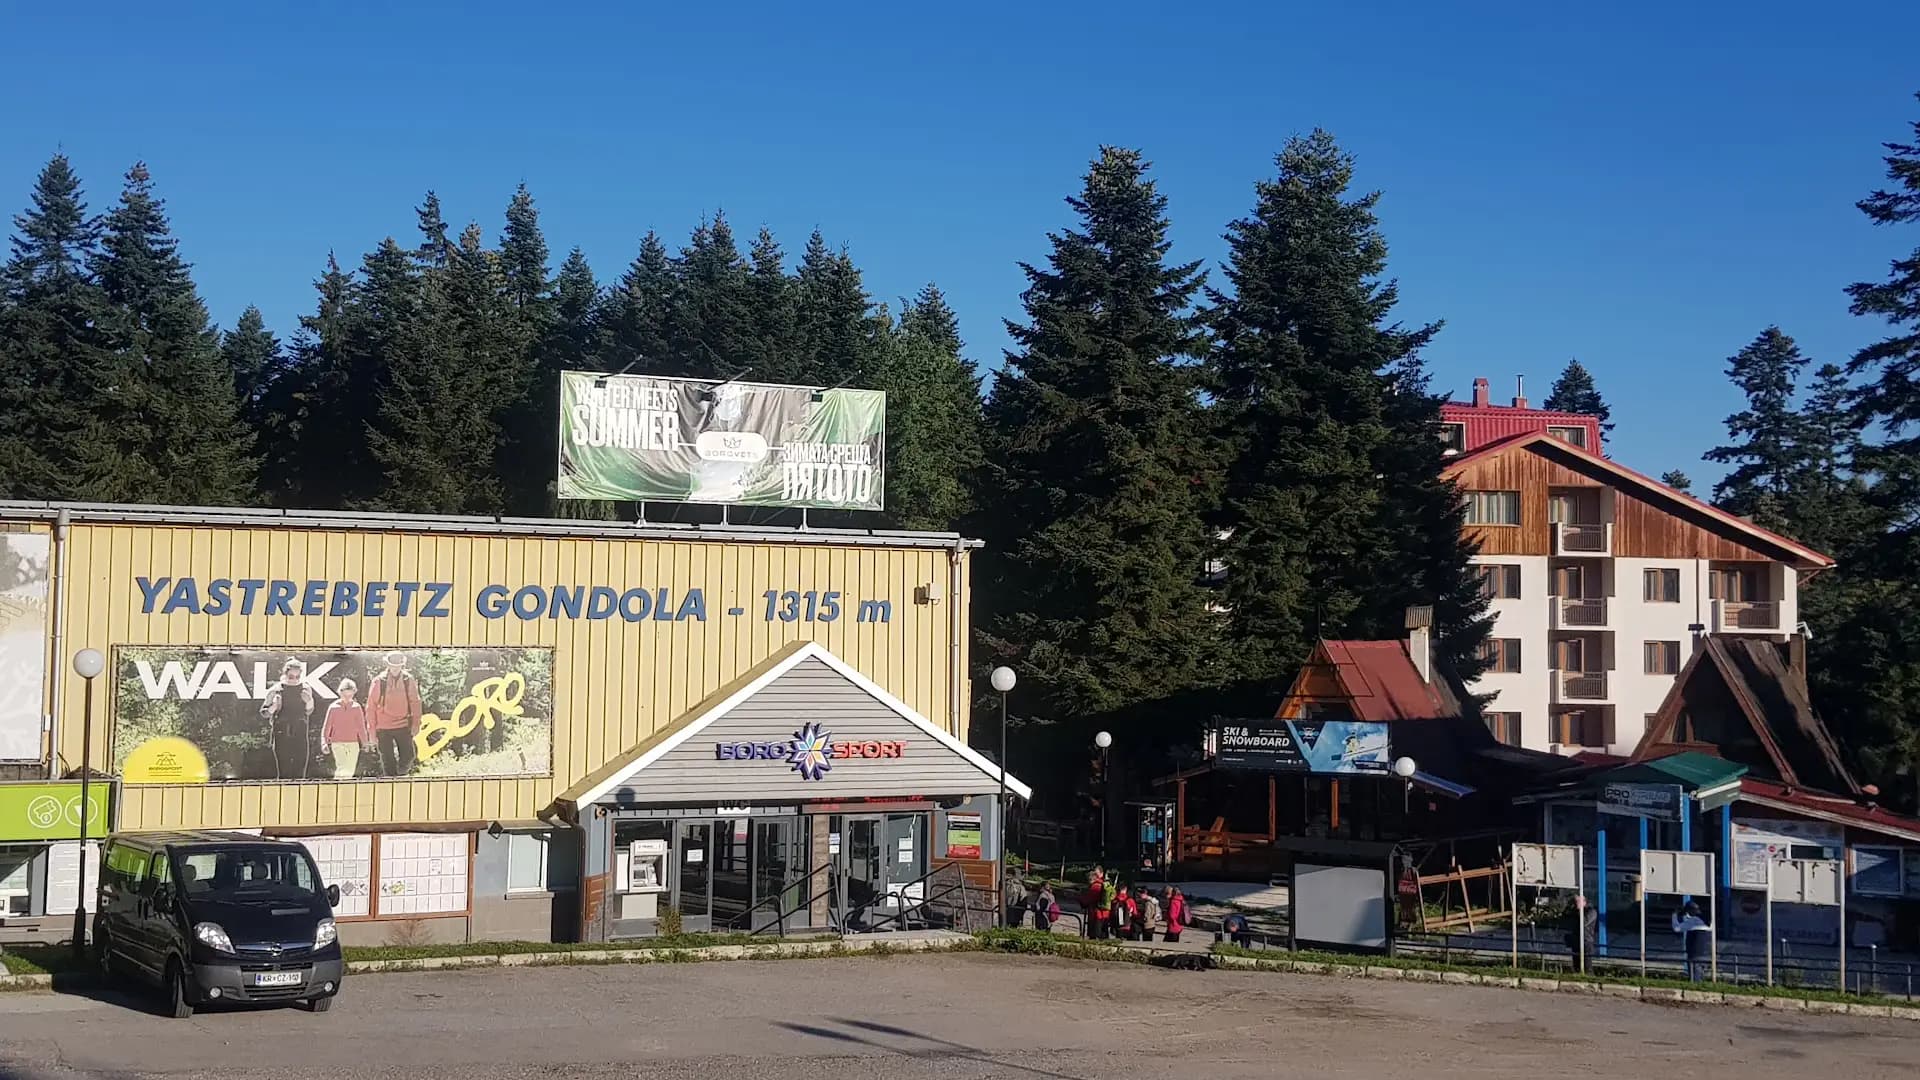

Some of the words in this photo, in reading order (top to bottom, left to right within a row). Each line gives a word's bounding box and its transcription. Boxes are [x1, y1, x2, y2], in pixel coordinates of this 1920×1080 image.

[575, 379, 631, 409] WINTER
[632, 386, 679, 412] MEETS
[572, 404, 680, 451] SUMMER
[783, 442, 828, 462] ЗИМАТА
[828, 443, 871, 465] СРЕЩА
[781, 462, 872, 503] ЛЯТОТО
[135, 577, 453, 618] YASTREBETZ
[476, 584, 707, 622] GONDOLA
[728, 607, 745, 616] -
[762, 590, 841, 622] 1315
[856, 598, 892, 623] m
[134, 661, 341, 700] WALK
[413, 671, 525, 761] BORO
[1223, 727, 1240, 735] SKI
[1241, 728, 1248, 736] &
[716, 742, 787, 760] BORO
[831, 741, 908, 759] SPORT
[1222, 736, 1290, 746] SNOWBOARD
